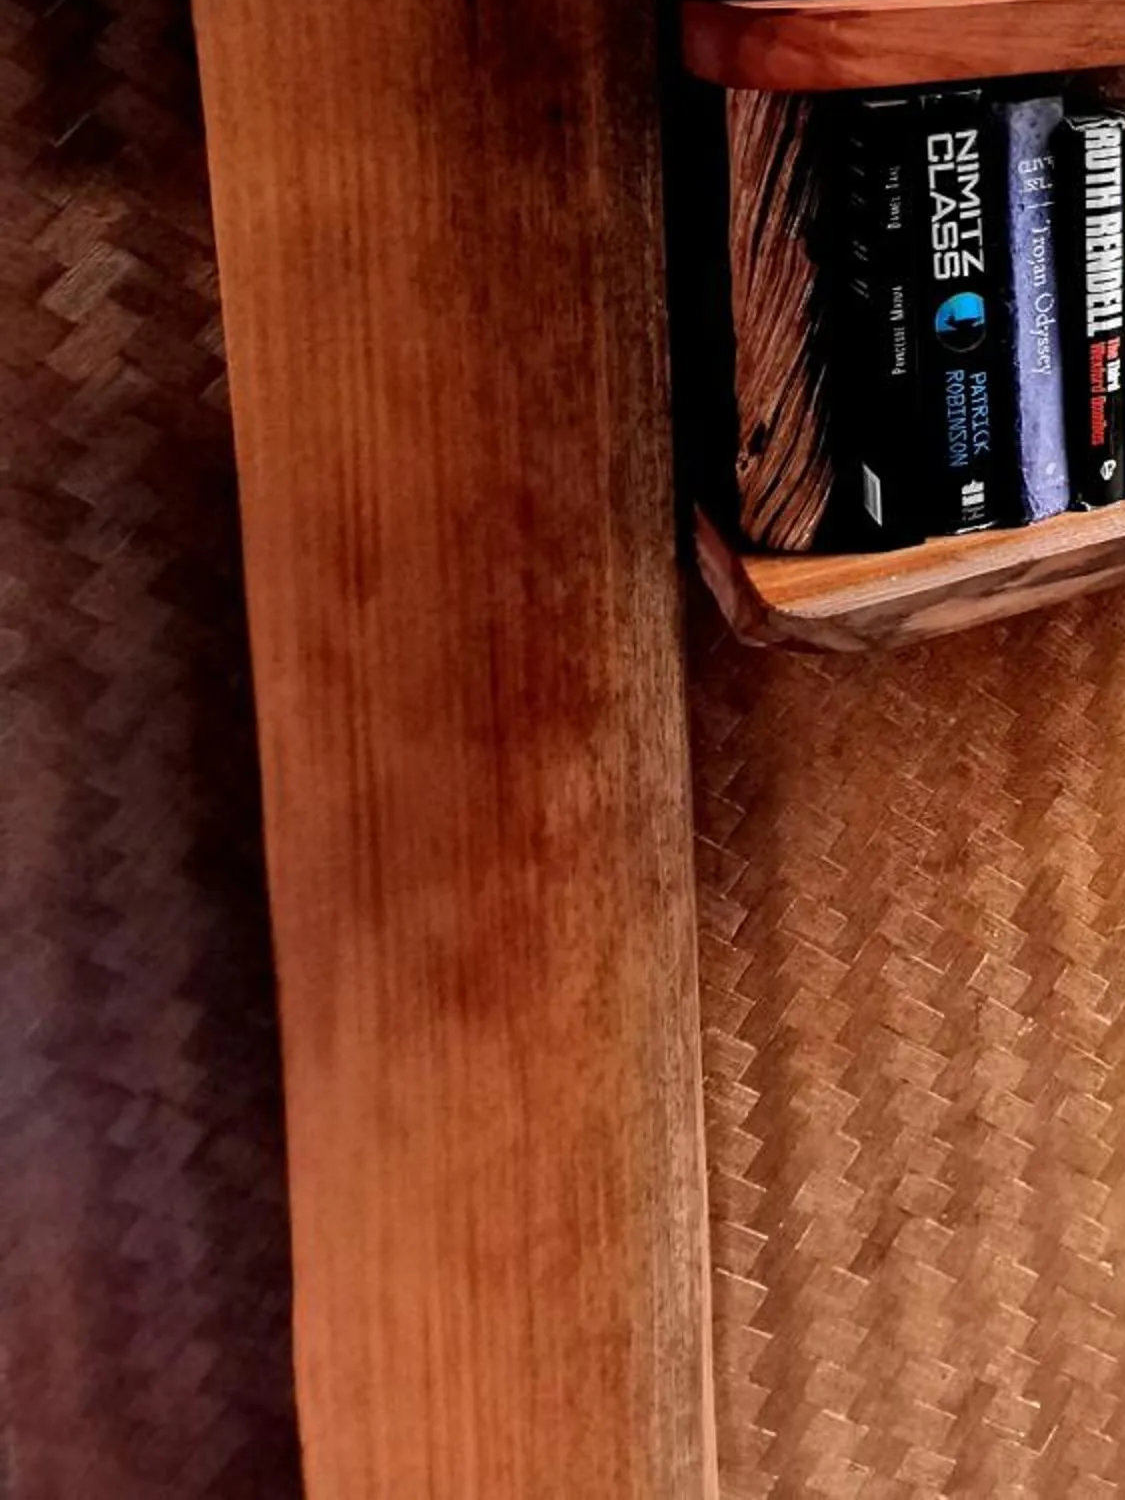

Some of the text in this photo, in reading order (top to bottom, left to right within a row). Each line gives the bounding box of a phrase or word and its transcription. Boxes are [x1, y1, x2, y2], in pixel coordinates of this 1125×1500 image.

[926, 132, 961, 281] CLASS
[954, 129, 984, 279] NIMITZ
[1084, 124, 1123, 338] RUTH RENDELL
[1029, 218, 1053, 289] Trojan
[1031, 293, 1056, 375] Odyssey
[1107, 336, 1120, 392] The Third
[945, 369, 969, 468] ROBINSON
[970, 370, 990, 454] PATRICK
